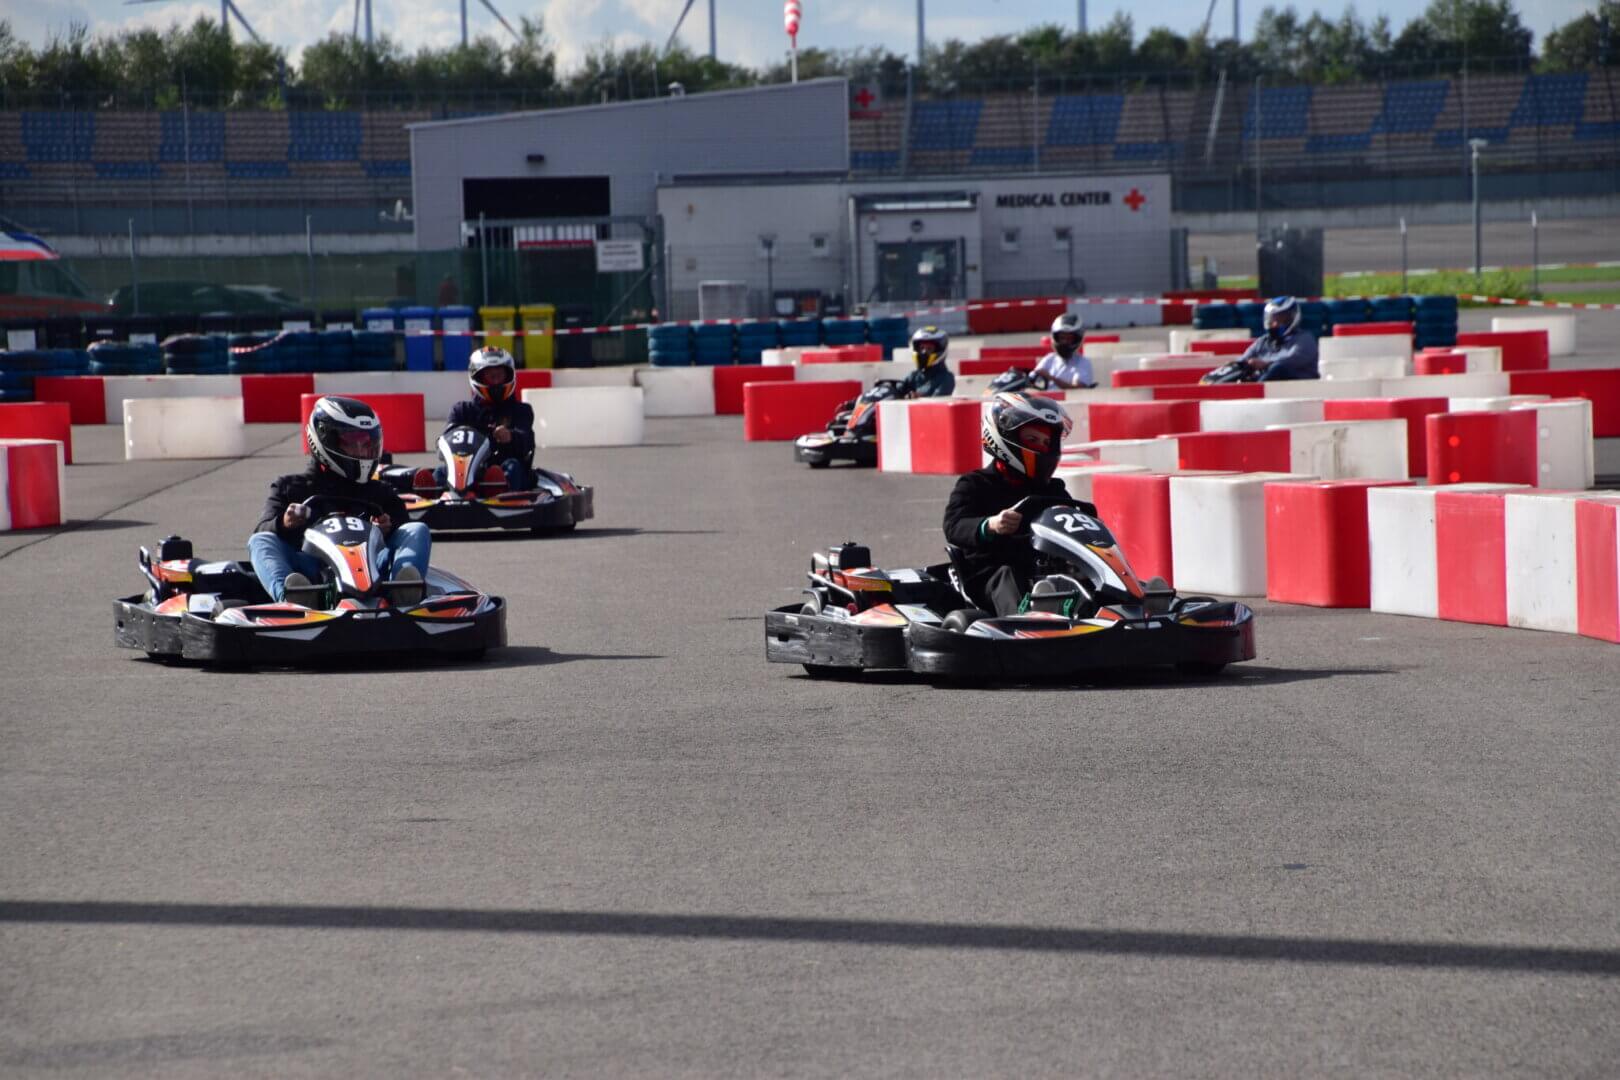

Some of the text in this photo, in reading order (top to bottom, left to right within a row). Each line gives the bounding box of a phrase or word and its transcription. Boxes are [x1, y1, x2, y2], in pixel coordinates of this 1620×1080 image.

[997, 191, 1112, 208] MEDICAL CENTER
[452, 430, 475, 444] 31
[322, 516, 365, 533] 39
[1054, 513, 1101, 533] 29
